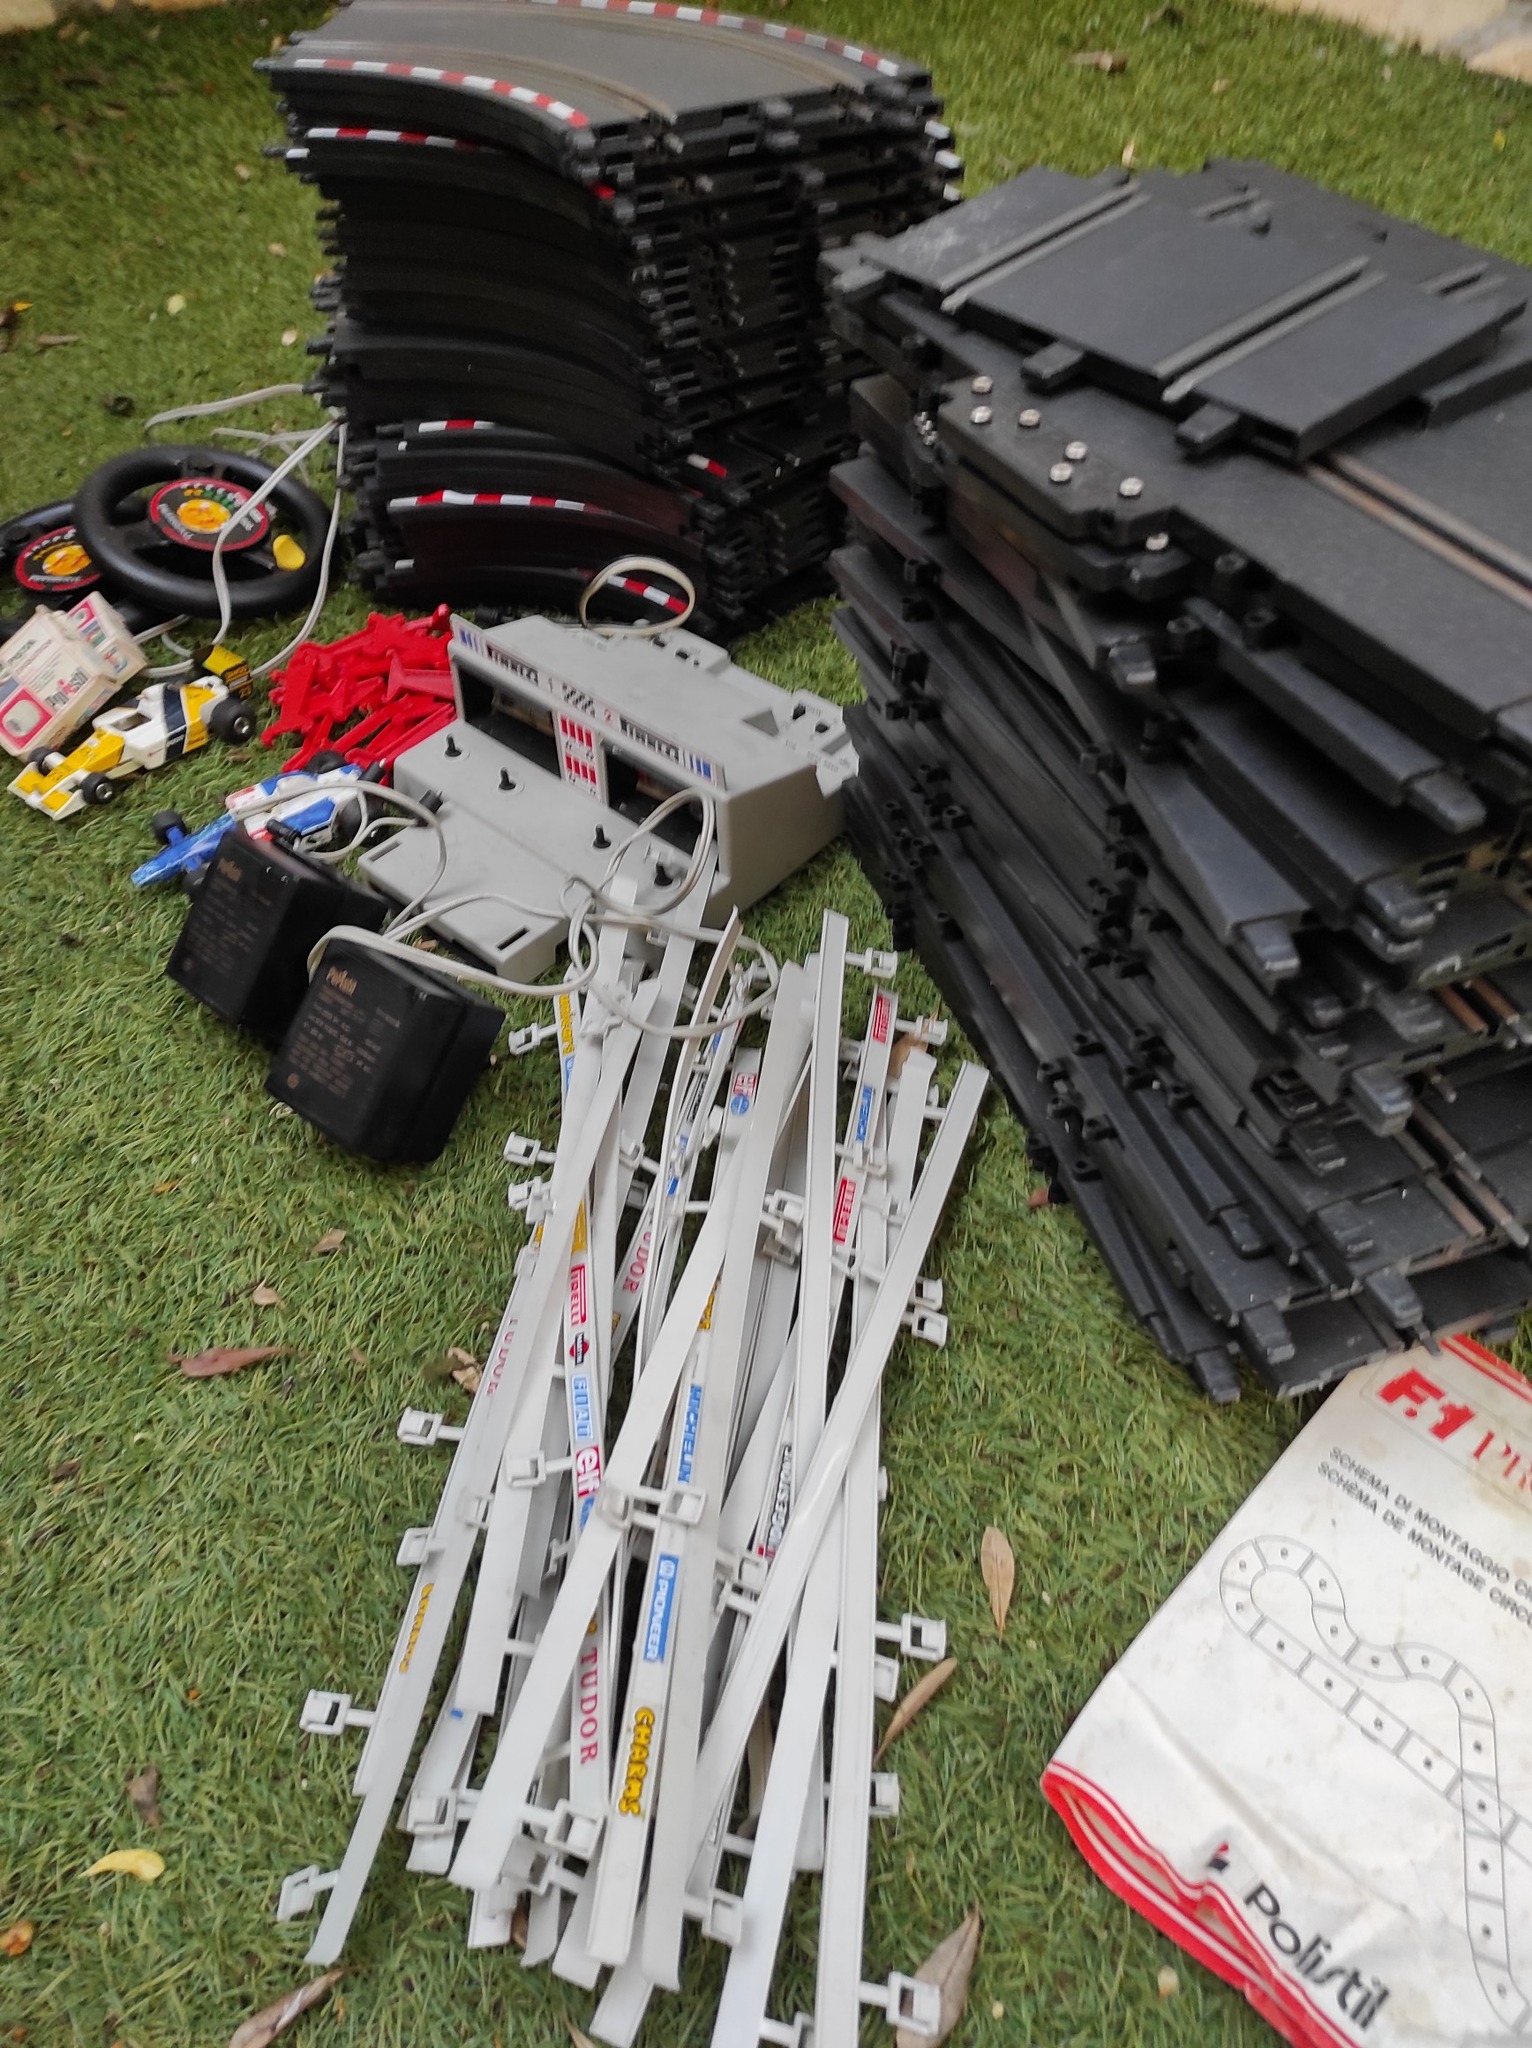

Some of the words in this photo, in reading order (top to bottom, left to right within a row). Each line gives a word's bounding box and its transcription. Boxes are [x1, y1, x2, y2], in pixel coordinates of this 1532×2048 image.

[570, 1263, 587, 1327] PIRELLI
[1329, 1446, 1390, 1500] SCHEMA
[1394, 1493, 1423, 1515] DI
[1413, 1507, 1510, 1584] MONTAGGIO
[1382, 1508, 1406, 1535] DE
[1407, 1527, 1486, 1594] MONTAGE
[646, 1577, 676, 1663] PIONEER
[580, 1647, 598, 1765] TUDOR
[618, 1706, 655, 1817] CHARMS
[1244, 1882, 1391, 2032] Polistil
